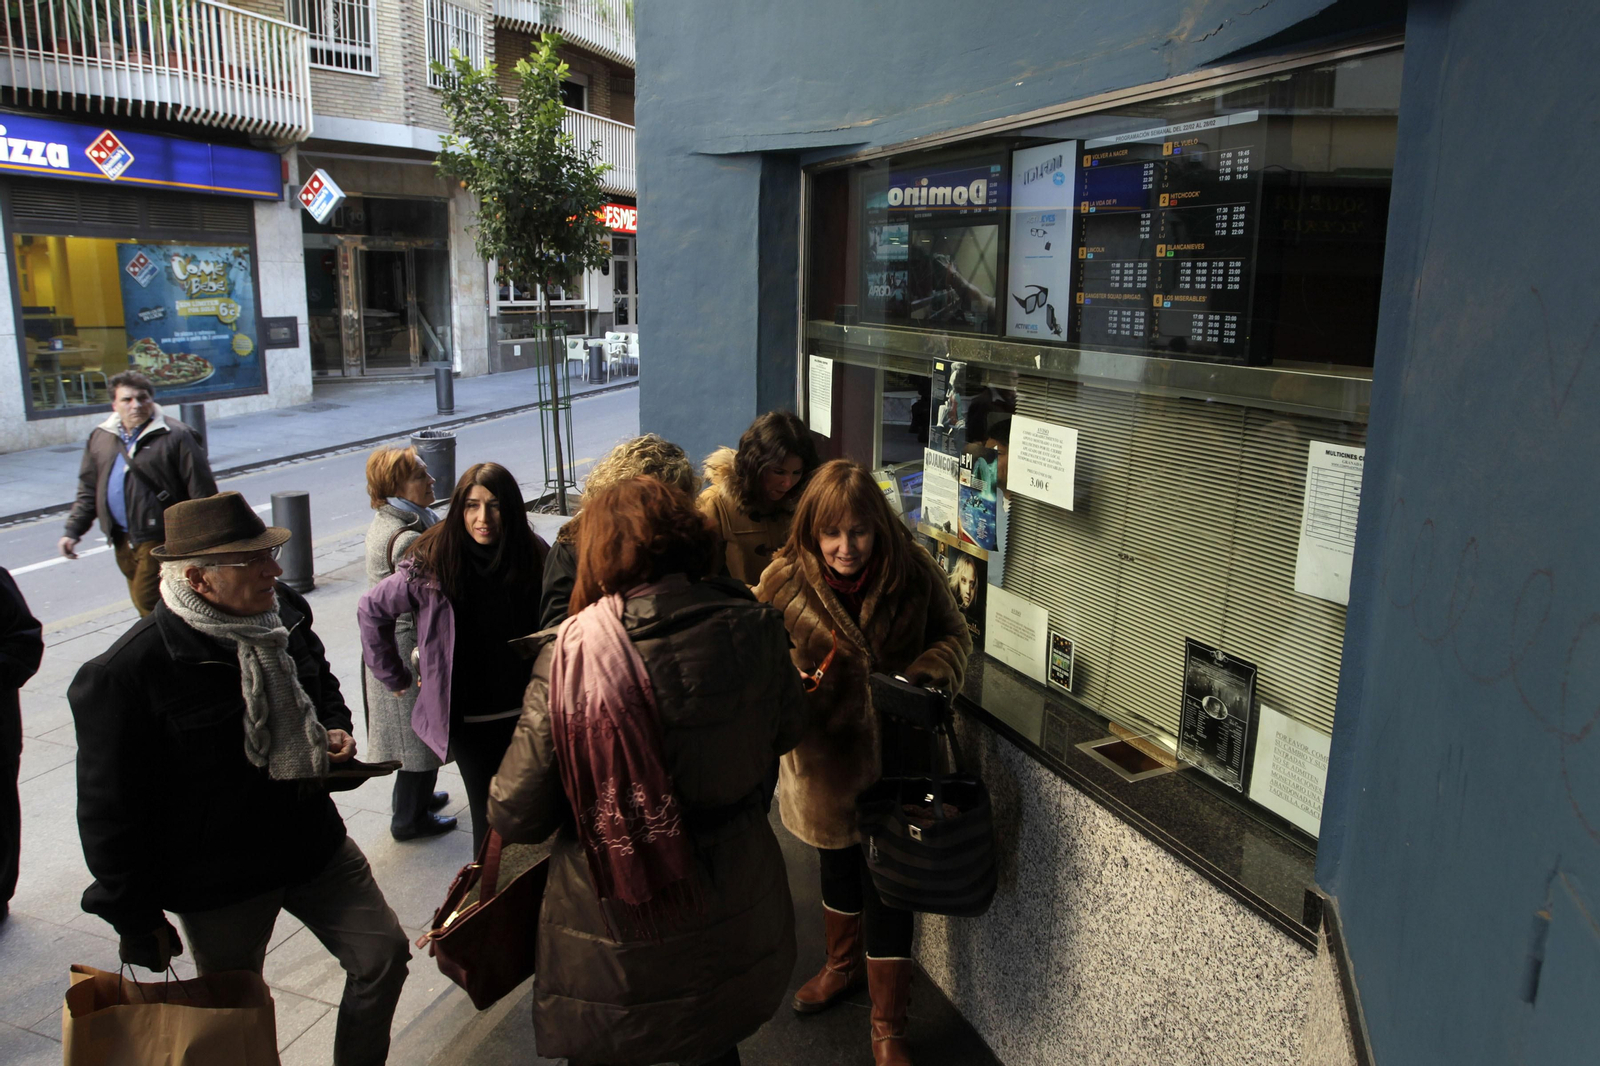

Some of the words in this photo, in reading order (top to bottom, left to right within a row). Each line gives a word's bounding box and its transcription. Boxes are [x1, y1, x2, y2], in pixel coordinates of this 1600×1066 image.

[1150, 128, 1173, 137] SEMANAL
[604, 205, 637, 231] ESME
[1325, 449, 1358, 461] MULTICINES
[1030, 477, 1044, 490] 3.00
[1045, 481, 1050, 492] €
[1276, 731, 1288, 743] POR
[1283, 743, 1308, 761] CAMBIO
[1291, 764, 1319, 784] ADMITEN
[1270, 777, 1312, 806] ABANDONADA
[1271, 770, 1306, 795] MONETARIO
[1307, 789, 1321, 802] UNA
